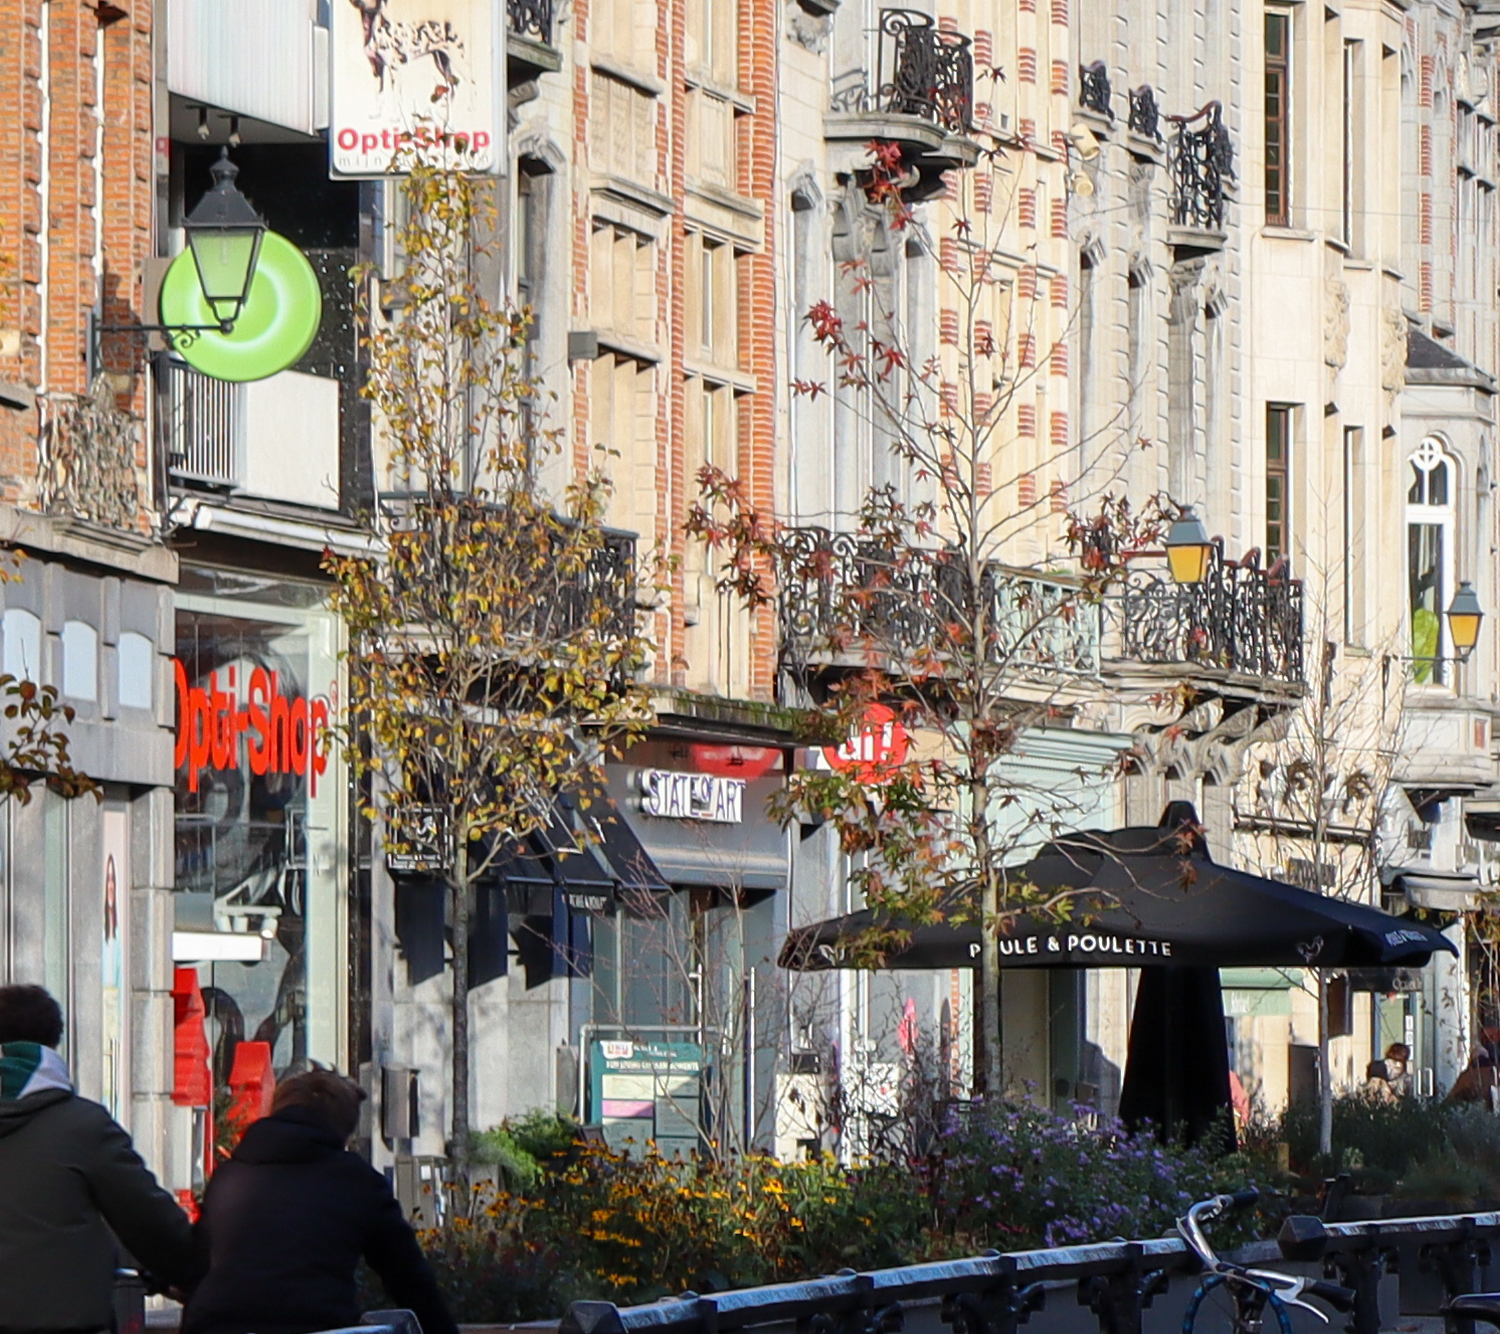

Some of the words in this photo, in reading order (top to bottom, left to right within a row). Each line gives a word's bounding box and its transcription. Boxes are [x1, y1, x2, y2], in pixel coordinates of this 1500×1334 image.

[648, 770, 700, 816] STATE
[714, 778, 745, 821] ART
[969, 935, 1039, 958] PULE
[1047, 936, 1061, 950] &
[1067, 935, 1172, 955] POULETTE
